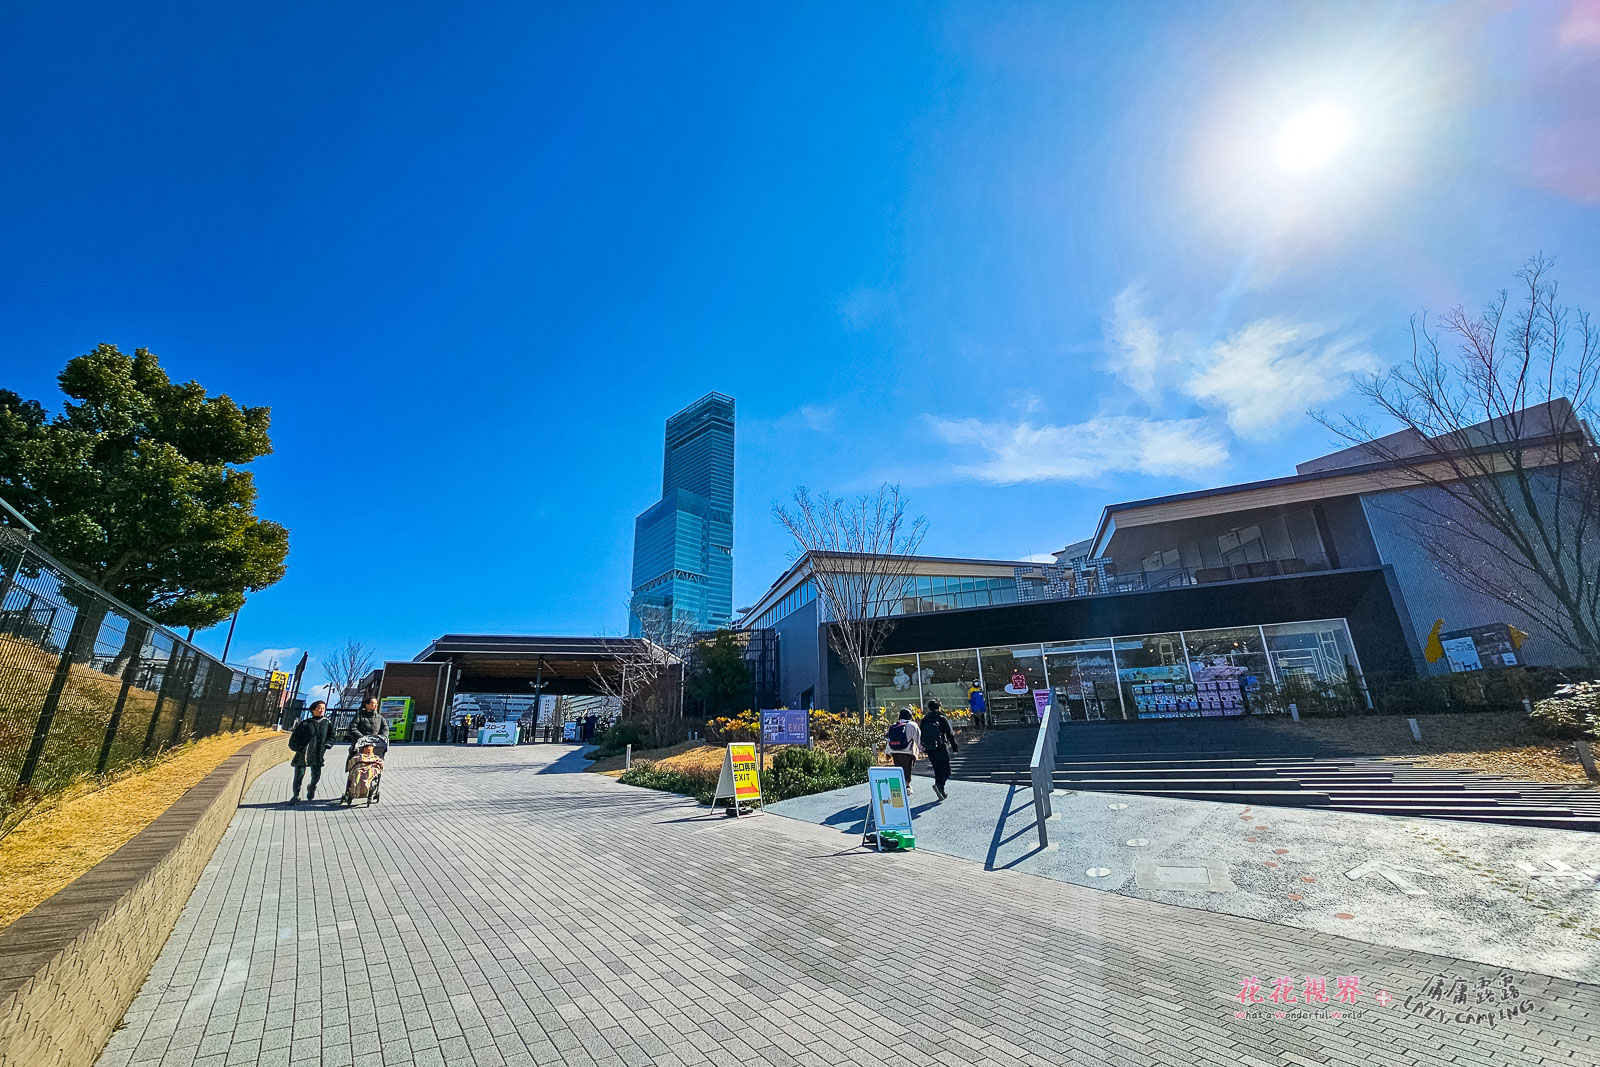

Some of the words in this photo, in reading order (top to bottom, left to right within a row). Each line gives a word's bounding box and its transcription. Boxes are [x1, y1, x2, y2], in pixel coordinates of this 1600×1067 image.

[1014, 557, 1113, 602] EXIT
[788, 723, 805, 733] EXIT
[732, 762, 756, 772] 出口専用
[733, 773, 750, 782] EXIT
